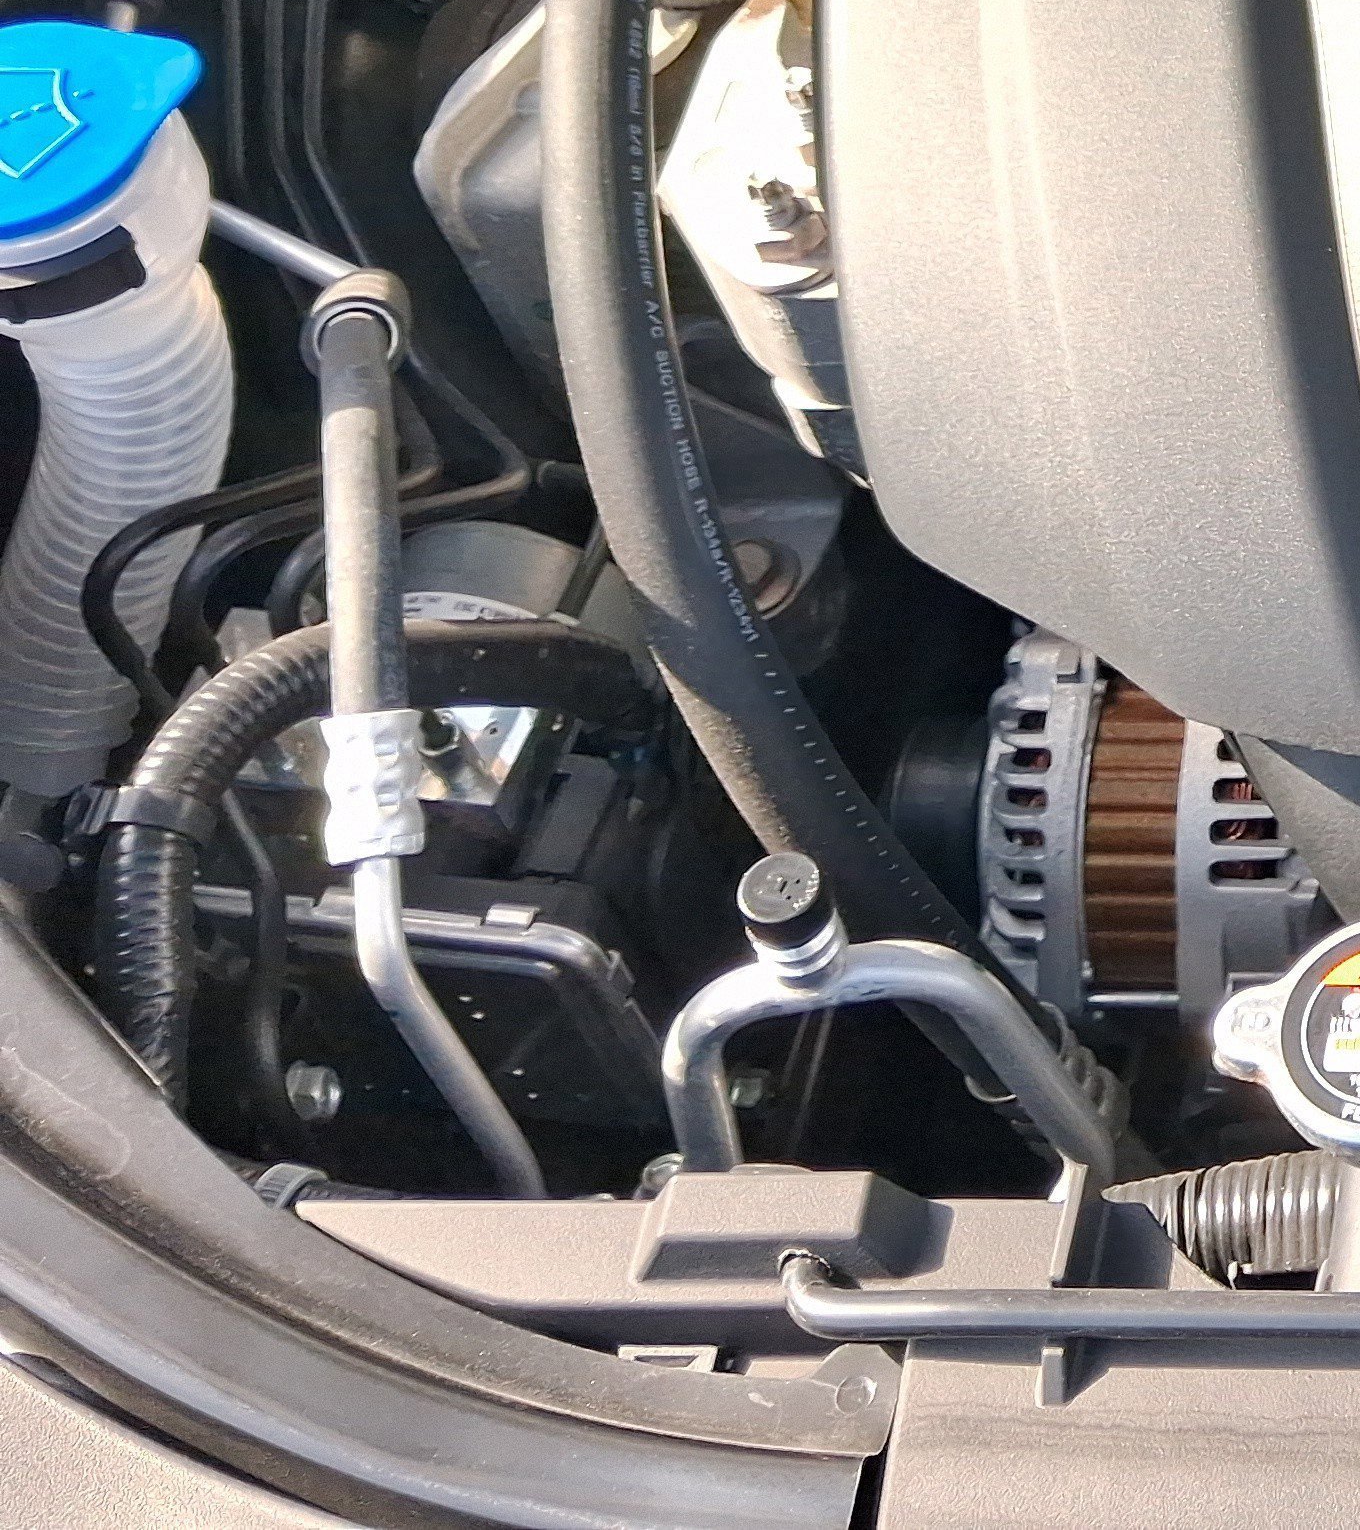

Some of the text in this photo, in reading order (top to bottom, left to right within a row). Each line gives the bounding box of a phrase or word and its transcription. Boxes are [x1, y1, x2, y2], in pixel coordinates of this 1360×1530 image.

[645, 300, 665, 339] A/C
[655, 350, 686, 430] SUCTION
[676, 438, 703, 491] HOSE
